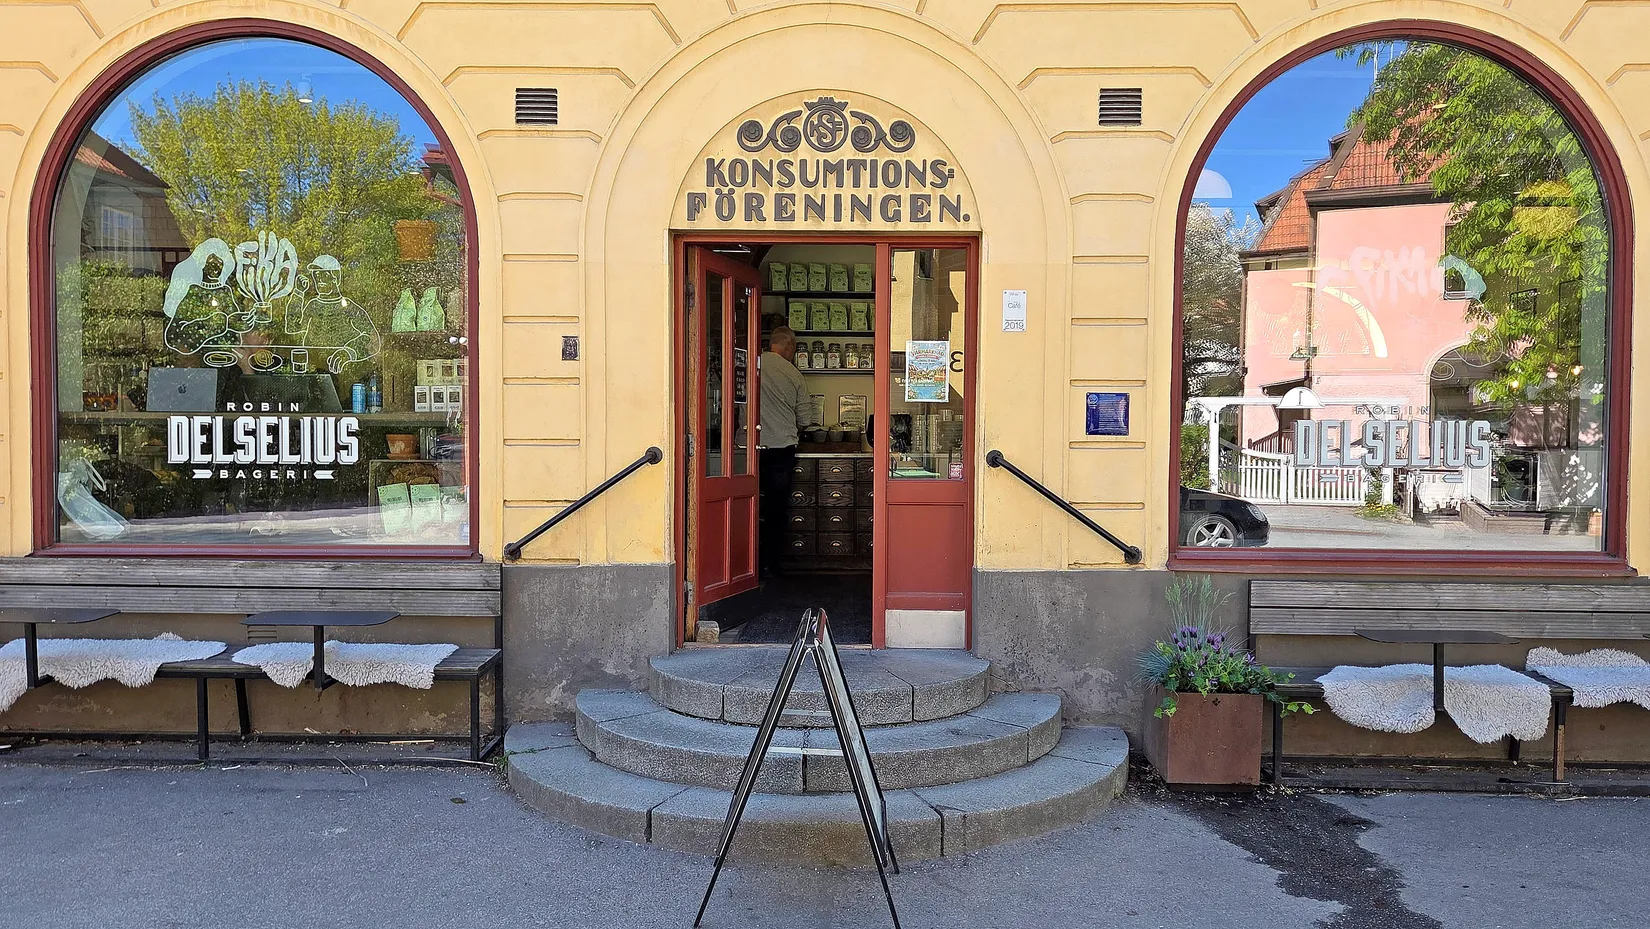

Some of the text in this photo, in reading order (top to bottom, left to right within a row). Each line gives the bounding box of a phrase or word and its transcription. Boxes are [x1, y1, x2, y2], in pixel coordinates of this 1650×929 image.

[686, 187, 971, 223] FÖRENINGEN.
[1004, 321, 1025, 330] 2019
[226, 402, 300, 412] ROBIN
[1355, 405, 1430, 415] ROBIN
[167, 415, 361, 465] DELSELIUS
[1293, 419, 1492, 469] DELSELIUS
[219, 470, 308, 480] BAGERI
[1346, 474, 1437, 484] BAGERI
